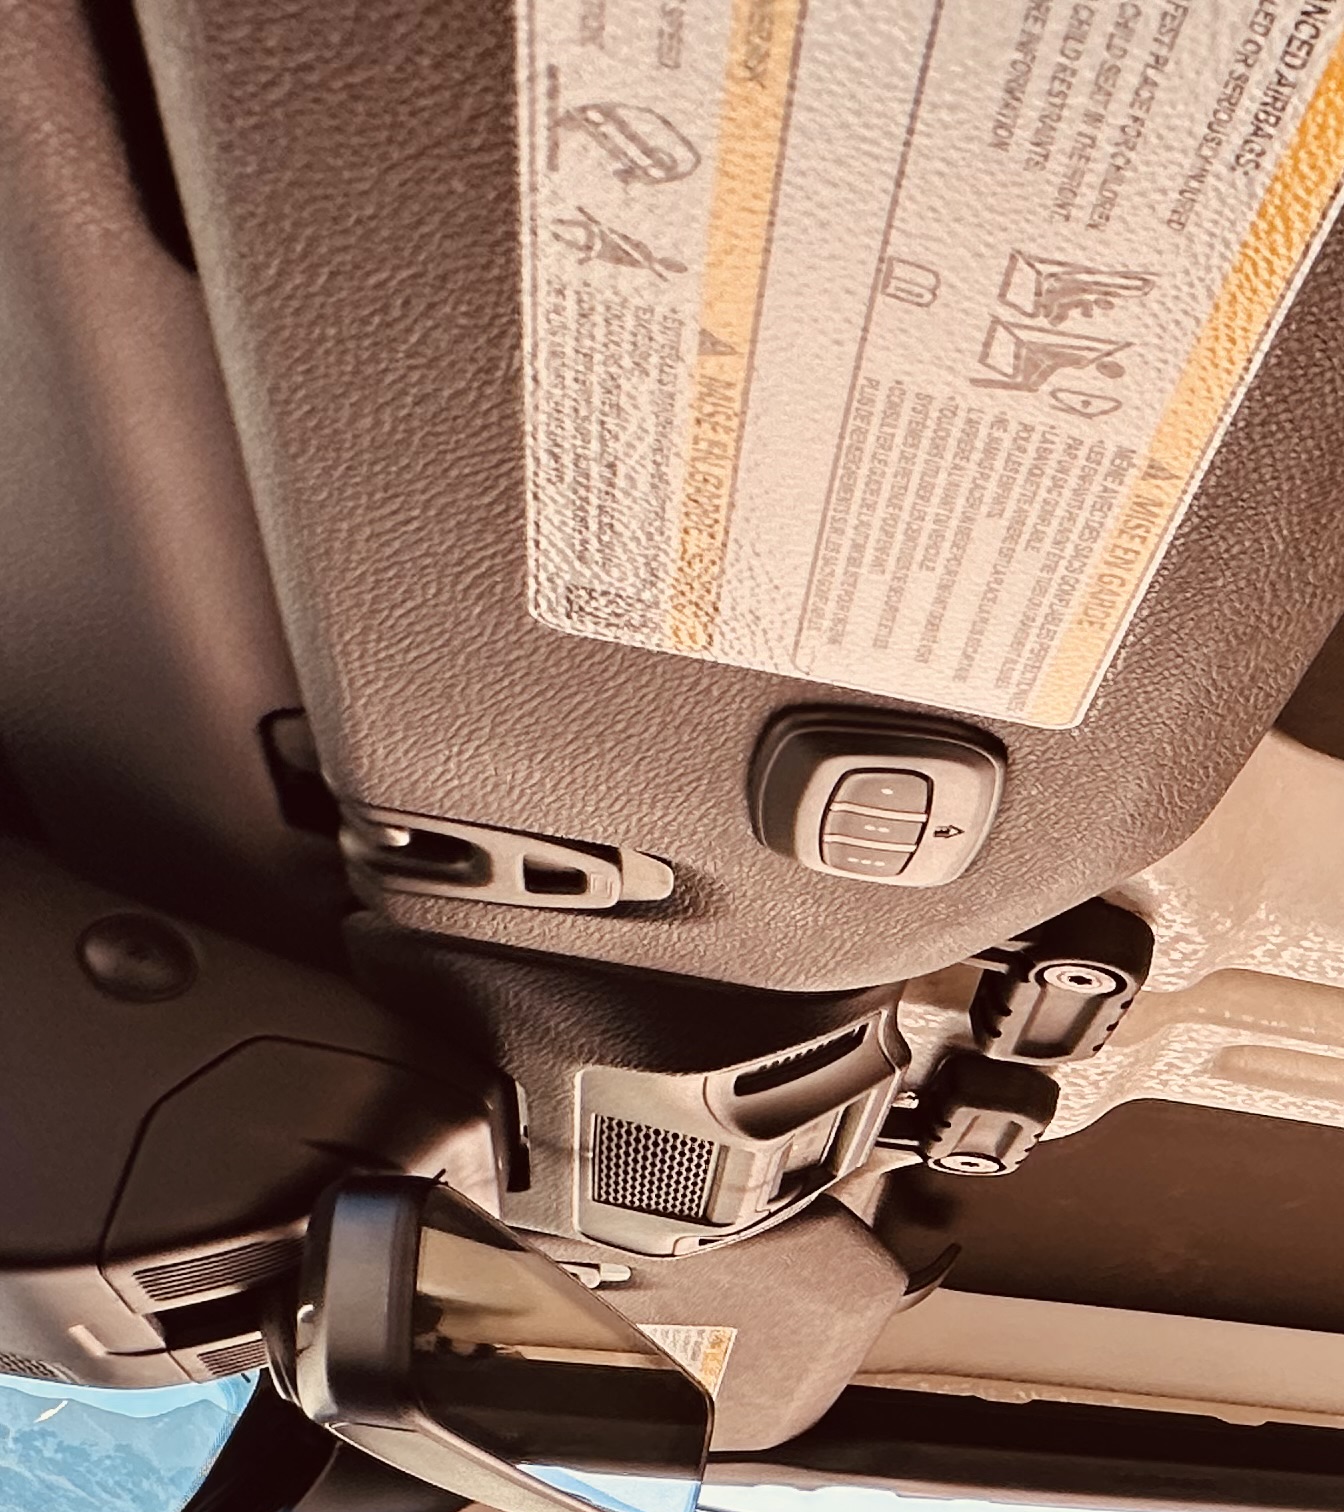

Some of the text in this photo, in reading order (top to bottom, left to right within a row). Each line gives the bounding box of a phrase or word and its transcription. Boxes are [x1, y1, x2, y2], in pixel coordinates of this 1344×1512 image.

[1128, 51, 1169, 114] PLACE
[1231, 38, 1263, 71] OR
[1086, 58, 1123, 112] SEAT
[1230, 0, 1331, 178] NCED AIRBAGS:
[1113, 113, 1145, 154] FOR
[694, 373, 737, 437] MISE
[1065, 541, 1094, 576] SACS
[1077, 492, 1164, 631] MISE EN GARDE
